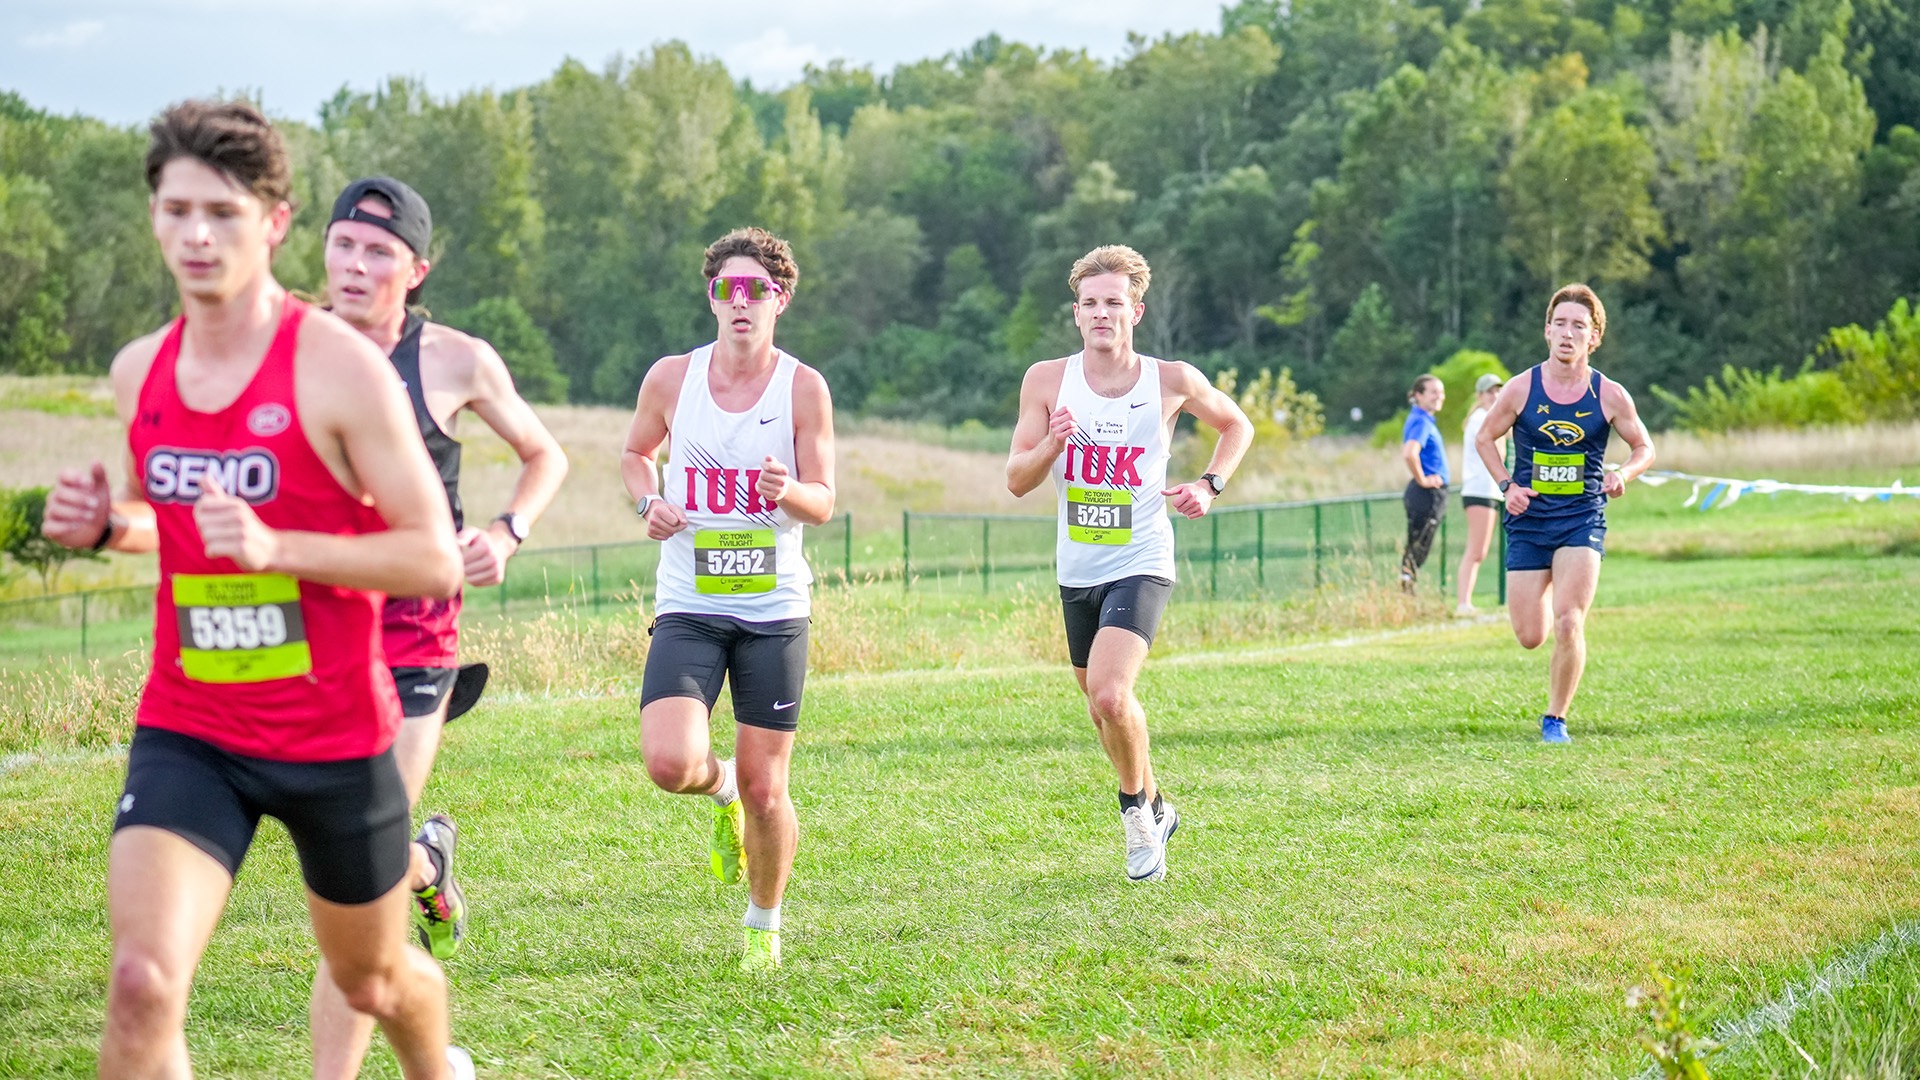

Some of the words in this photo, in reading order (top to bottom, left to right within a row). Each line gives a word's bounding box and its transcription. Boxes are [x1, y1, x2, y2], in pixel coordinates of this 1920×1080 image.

[147, 452, 274, 499] SEMO
[1064, 443, 1145, 486] IUK
[1539, 465, 1577, 482] 5428
[1077, 504, 1120, 527] 5251
[707, 549, 765, 575] 5252
[189, 603, 287, 650] 5359
